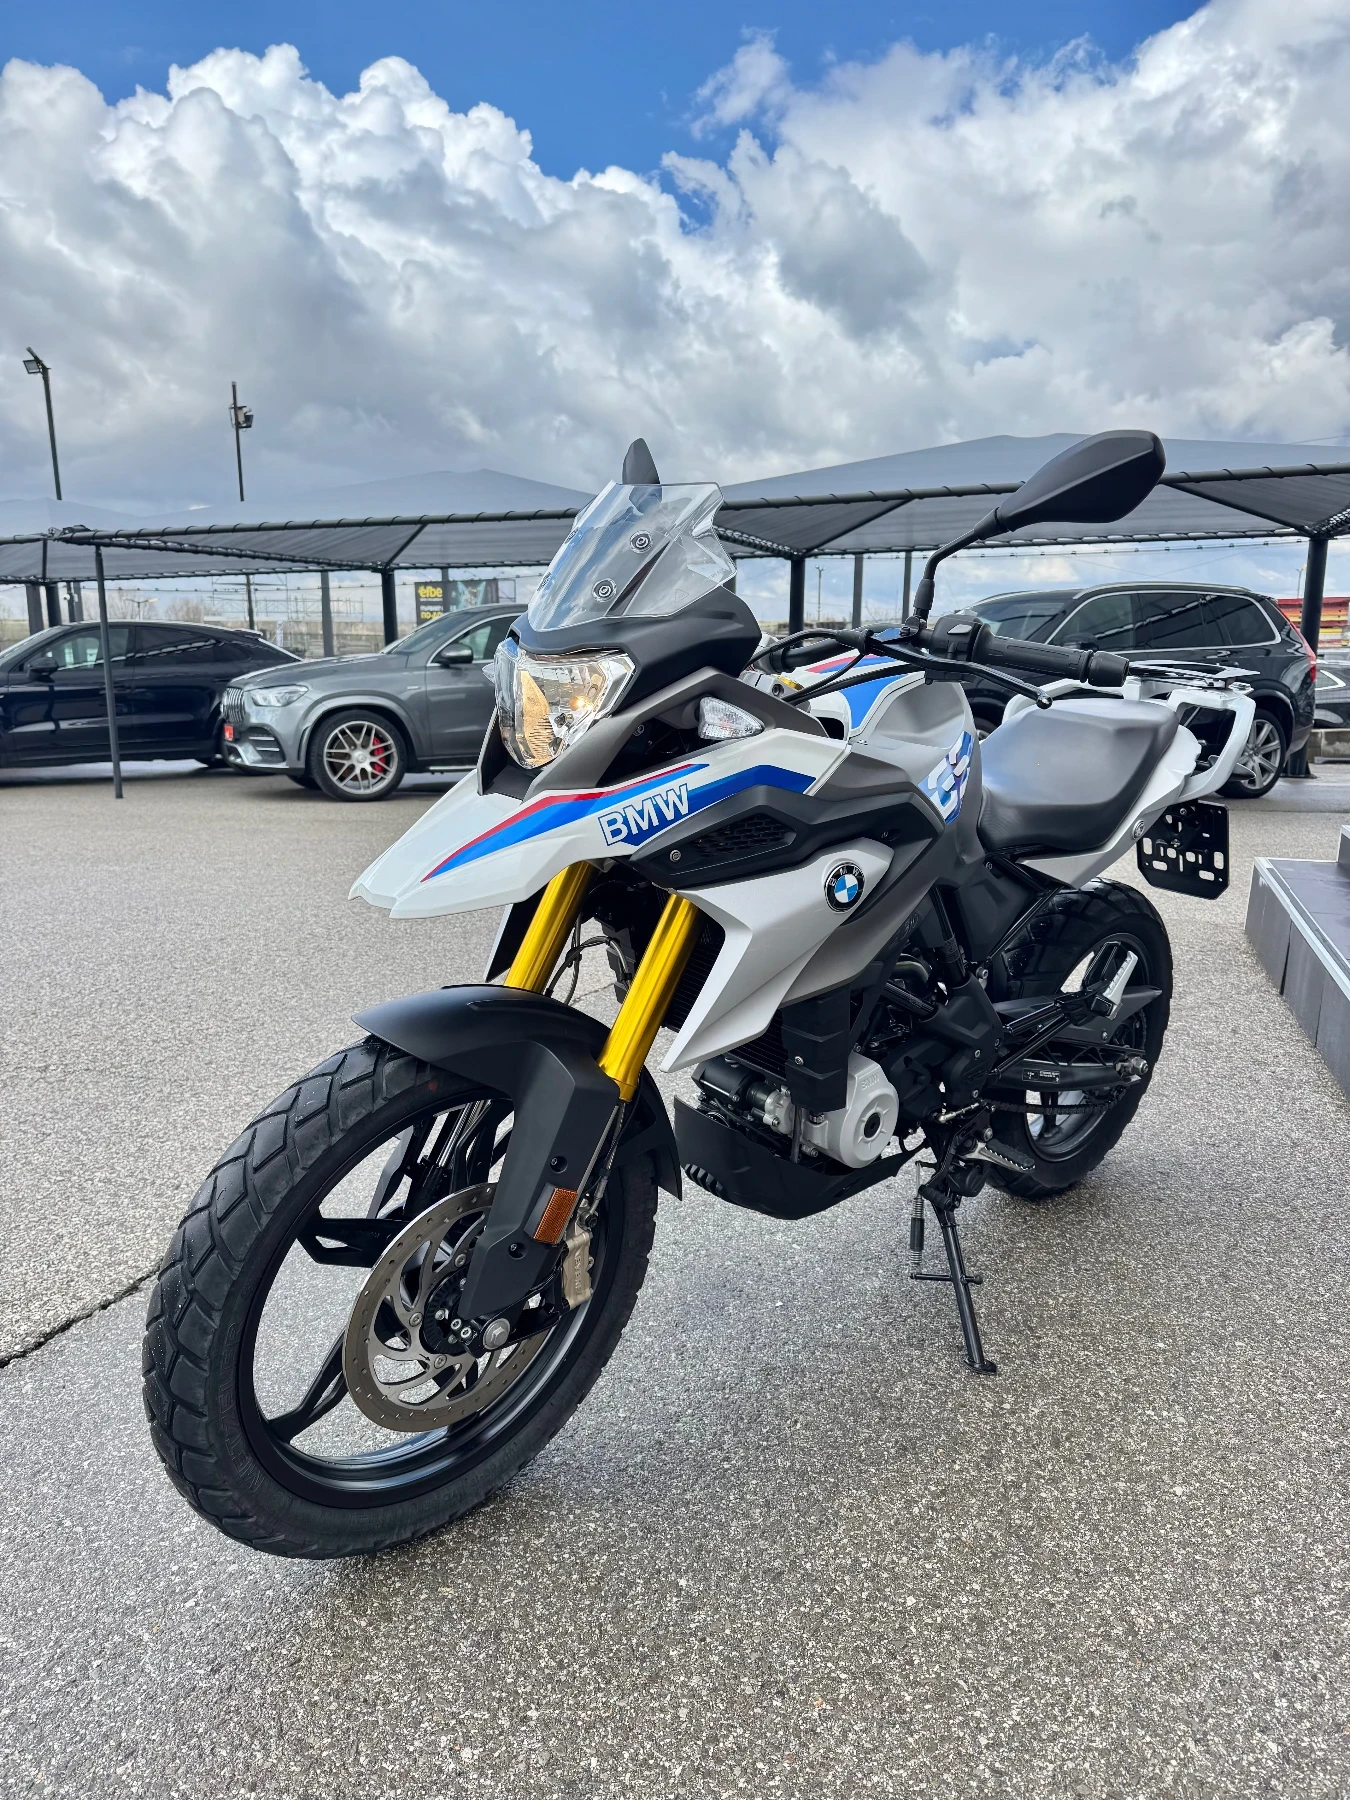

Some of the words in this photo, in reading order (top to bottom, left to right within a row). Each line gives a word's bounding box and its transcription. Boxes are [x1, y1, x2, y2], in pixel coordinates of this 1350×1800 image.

[597, 783, 689, 846] BMW
[829, 866, 860, 887] BMW
[218, 1322, 266, 1493] METZELER
